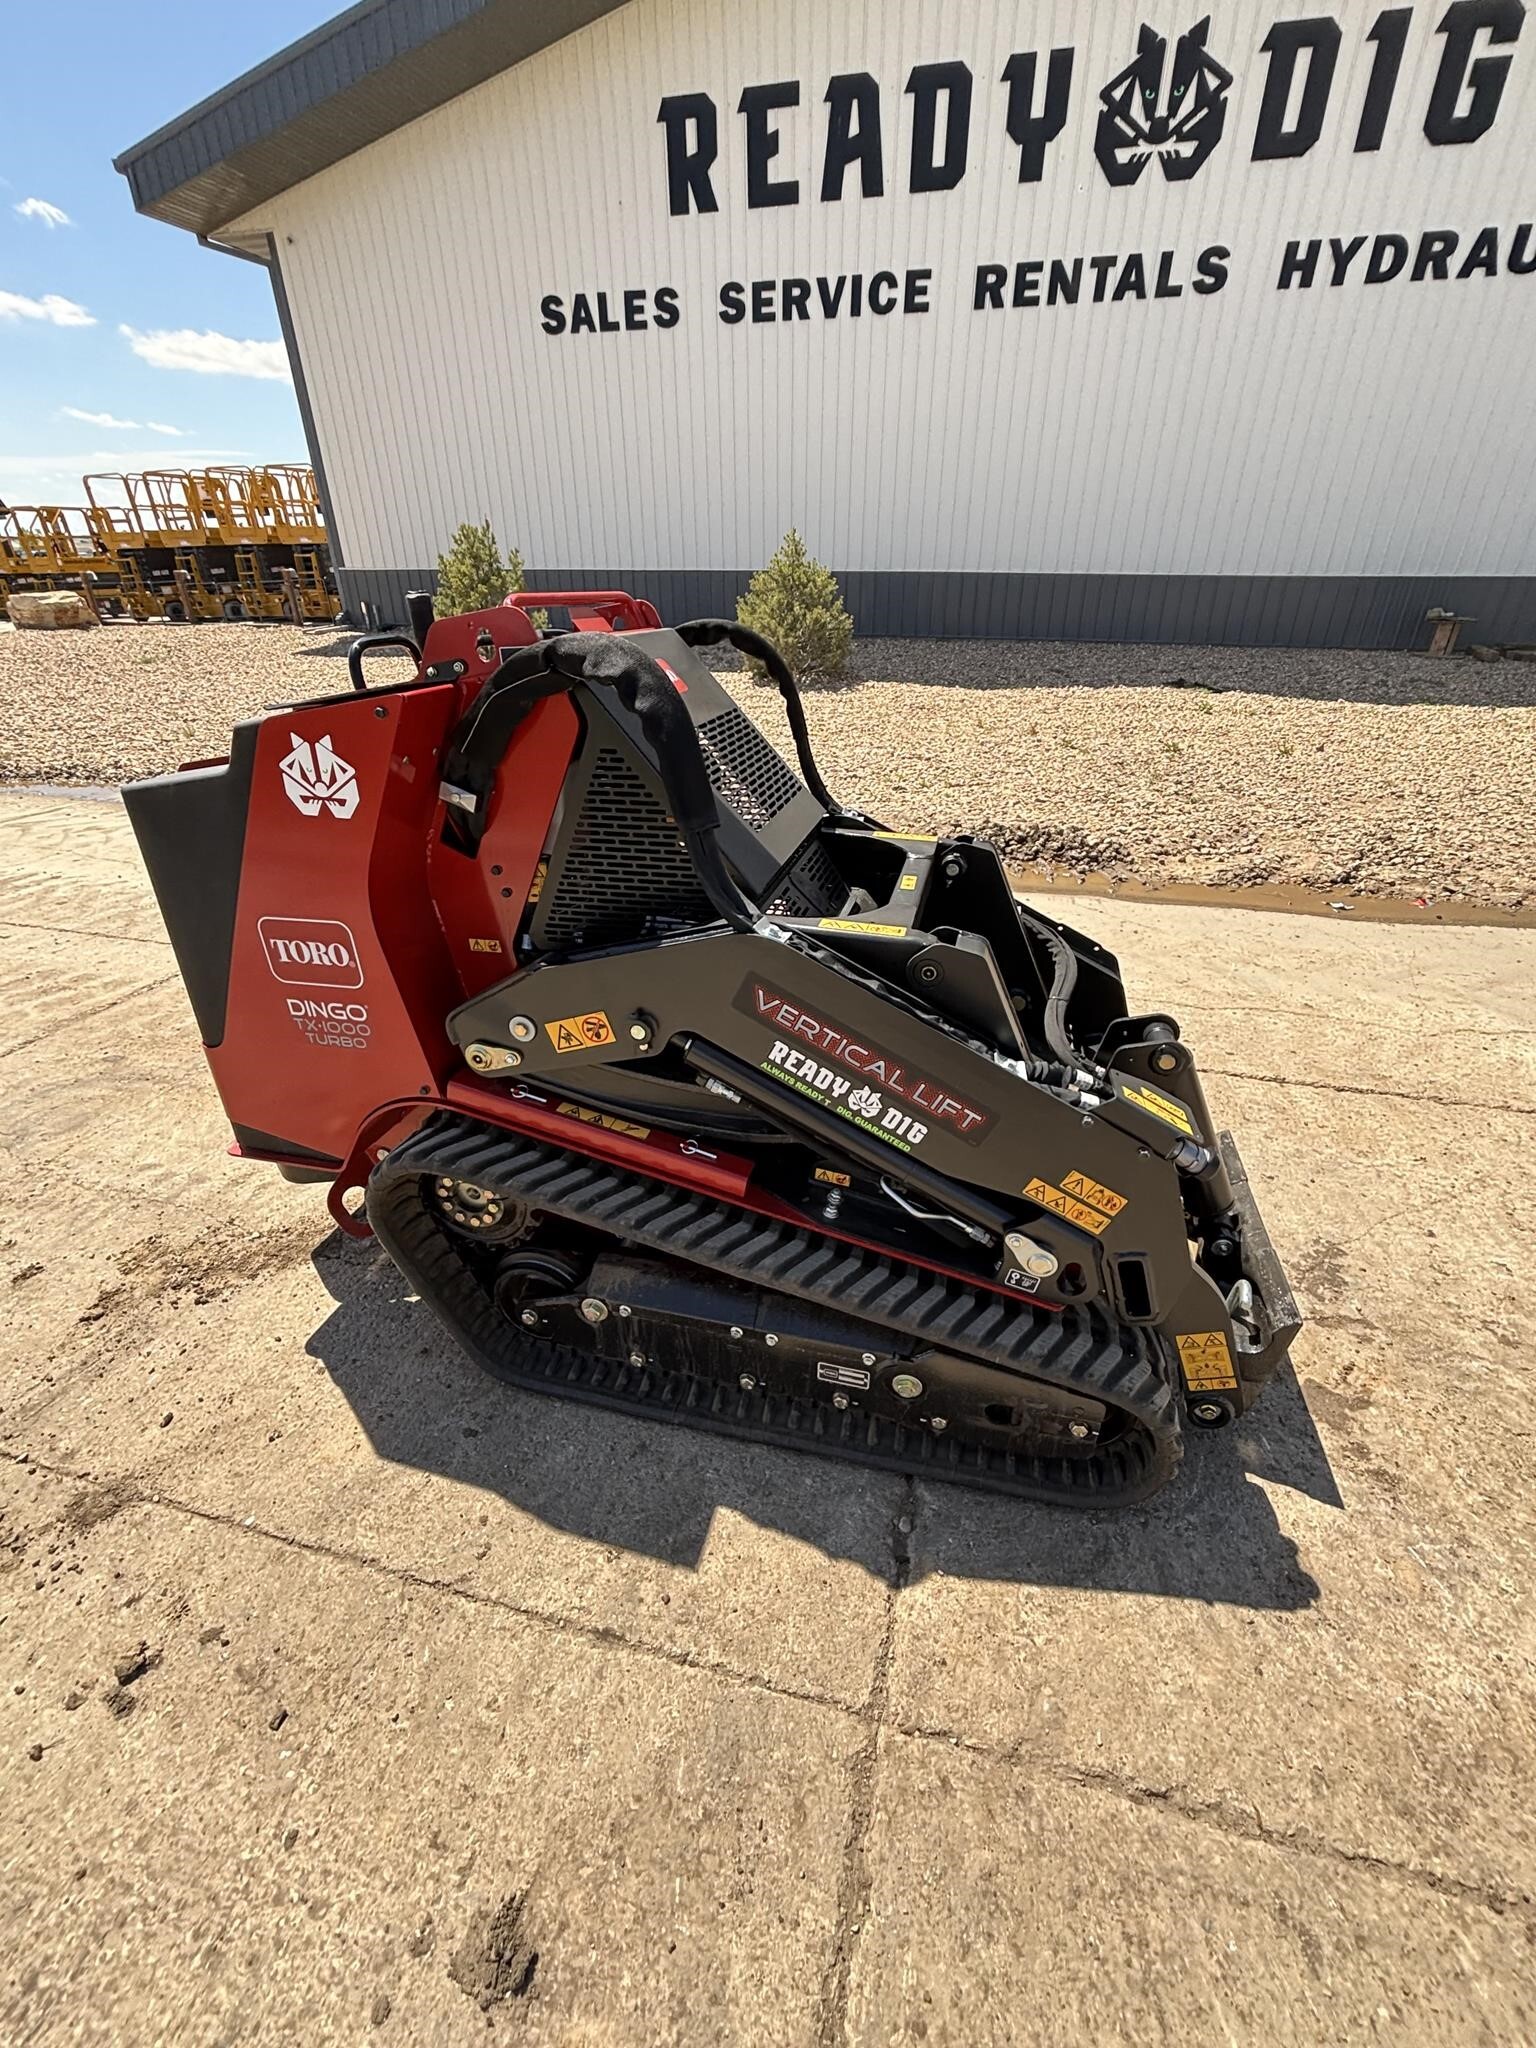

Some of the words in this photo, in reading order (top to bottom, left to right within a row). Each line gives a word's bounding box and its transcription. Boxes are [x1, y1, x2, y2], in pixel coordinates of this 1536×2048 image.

[657, 47, 1074, 216] READY
[1251, 0, 1527, 162] DIG
[541, 287, 681, 336] SALES
[719, 268, 932, 325] SERVICE
[973, 245, 1231, 311] RENTALS
[269, 938, 350, 967] TORO
[286, 998, 368, 1022] DINGO
[304, 1032, 367, 1049] TURBO
[756, 988, 905, 1093] VERTICAL
[911, 1083, 983, 1129] LIFT
[768, 1040, 851, 1098] READY
[880, 1107, 929, 1144] DIG
[760, 1061, 796, 1085] ALWAYS
[794, 1080, 826, 1102] READY
[854, 1116, 912, 1153] GUARANTEED
